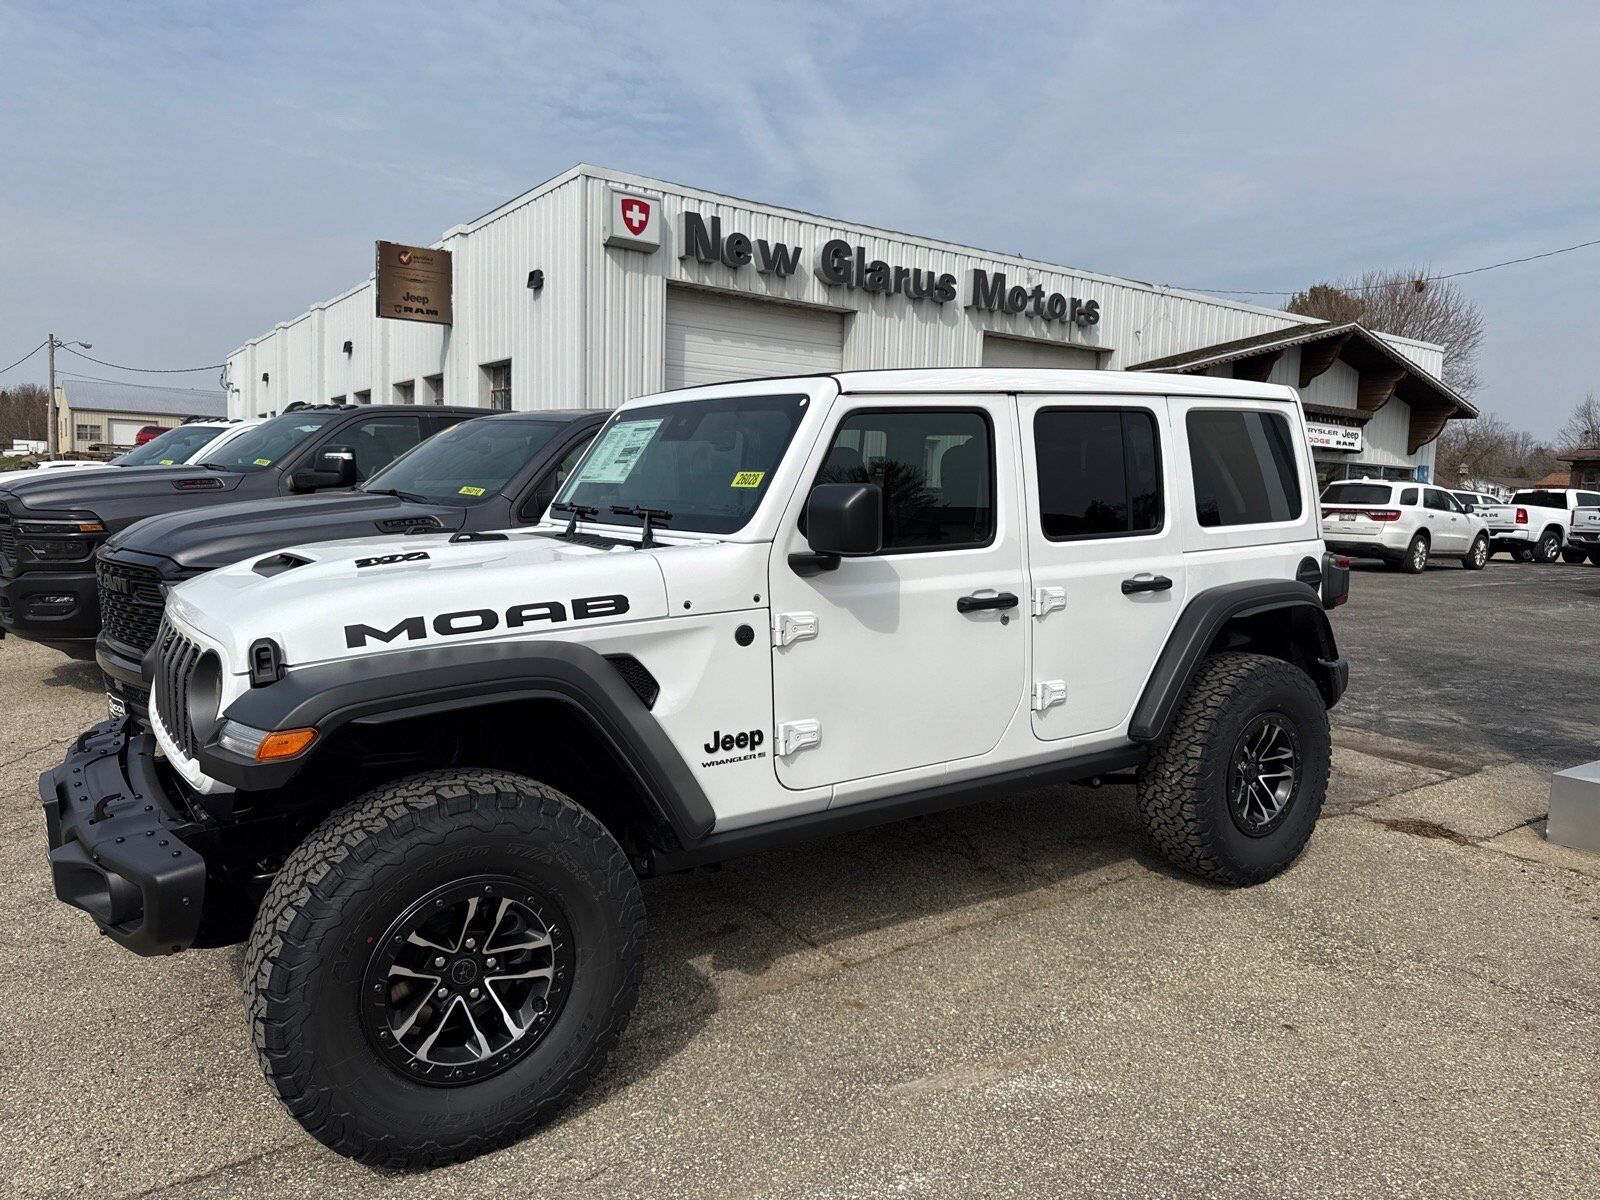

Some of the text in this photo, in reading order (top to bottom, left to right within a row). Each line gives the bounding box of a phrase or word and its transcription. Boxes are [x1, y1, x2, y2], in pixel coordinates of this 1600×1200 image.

[680, 211, 1100, 326] New Glarus Motors
[402, 292, 429, 306] Jeep
[403, 306, 439, 316] RAM
[1342, 429, 1359, 441] Jeep
[344, 594, 630, 649] MOAB
[703, 729, 764, 754] Jeep
[701, 754, 757, 768] WRANGLER
